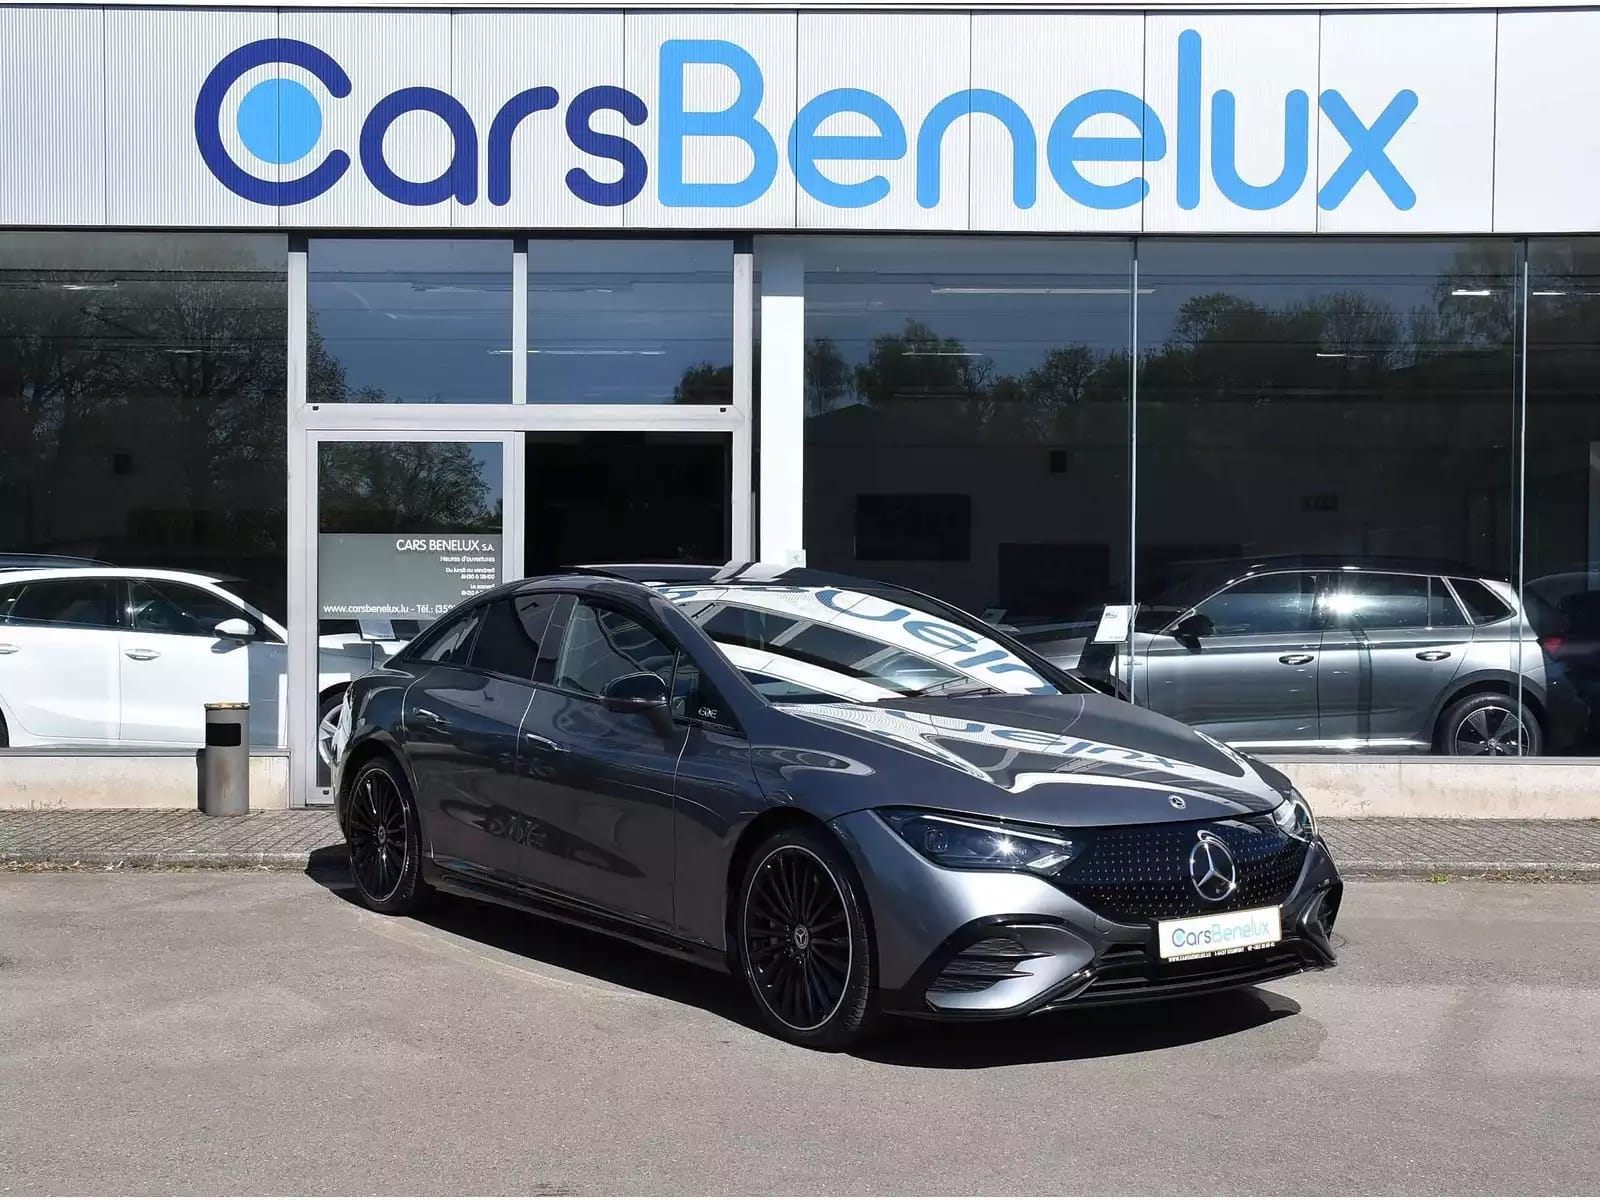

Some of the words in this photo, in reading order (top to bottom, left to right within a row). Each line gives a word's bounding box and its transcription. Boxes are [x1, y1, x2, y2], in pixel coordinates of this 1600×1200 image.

[195, 29, 1418, 211] CarsBenelux
[396, 539, 427, 551] CARS
[429, 539, 480, 551] BENELUX
[481, 543, 495, 551] S.A.
[323, 603, 409, 614] www.carsbenelux.lu
[1172, 917, 1269, 947] CarsBenelux
